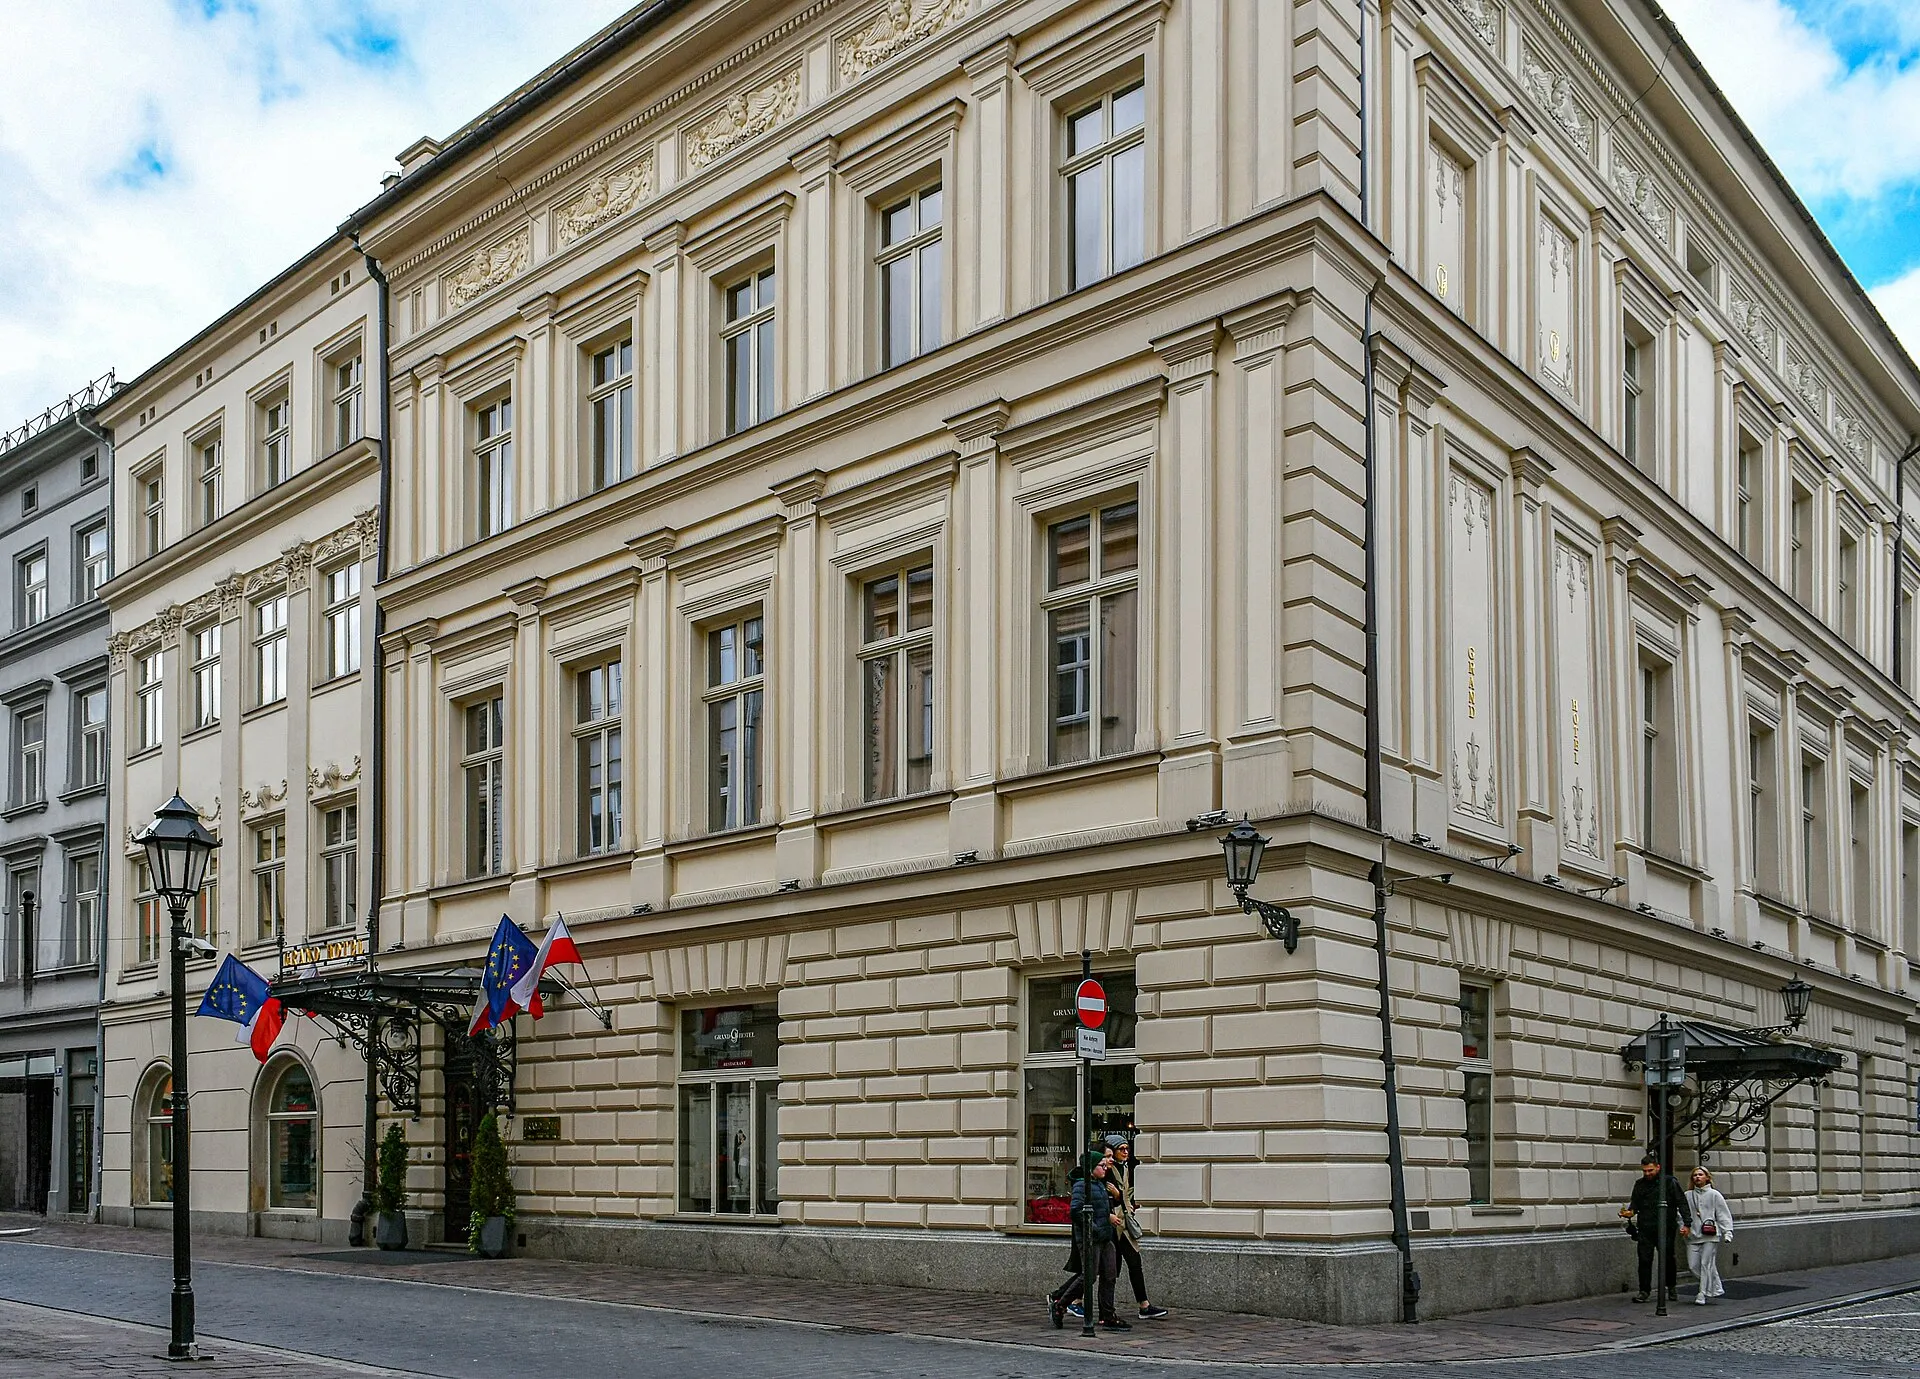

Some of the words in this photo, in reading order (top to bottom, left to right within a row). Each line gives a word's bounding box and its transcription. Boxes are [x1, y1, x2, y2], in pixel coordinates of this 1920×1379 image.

[1467, 646, 1476, 719] GRAND
[1571, 699, 1579, 766] HOTEL
[283, 946, 321, 967] GRAND
[326, 938, 365, 960] HOTEL
[1053, 1008, 1076, 1017] GRAND
[738, 1031, 755, 1039] HOTEL
